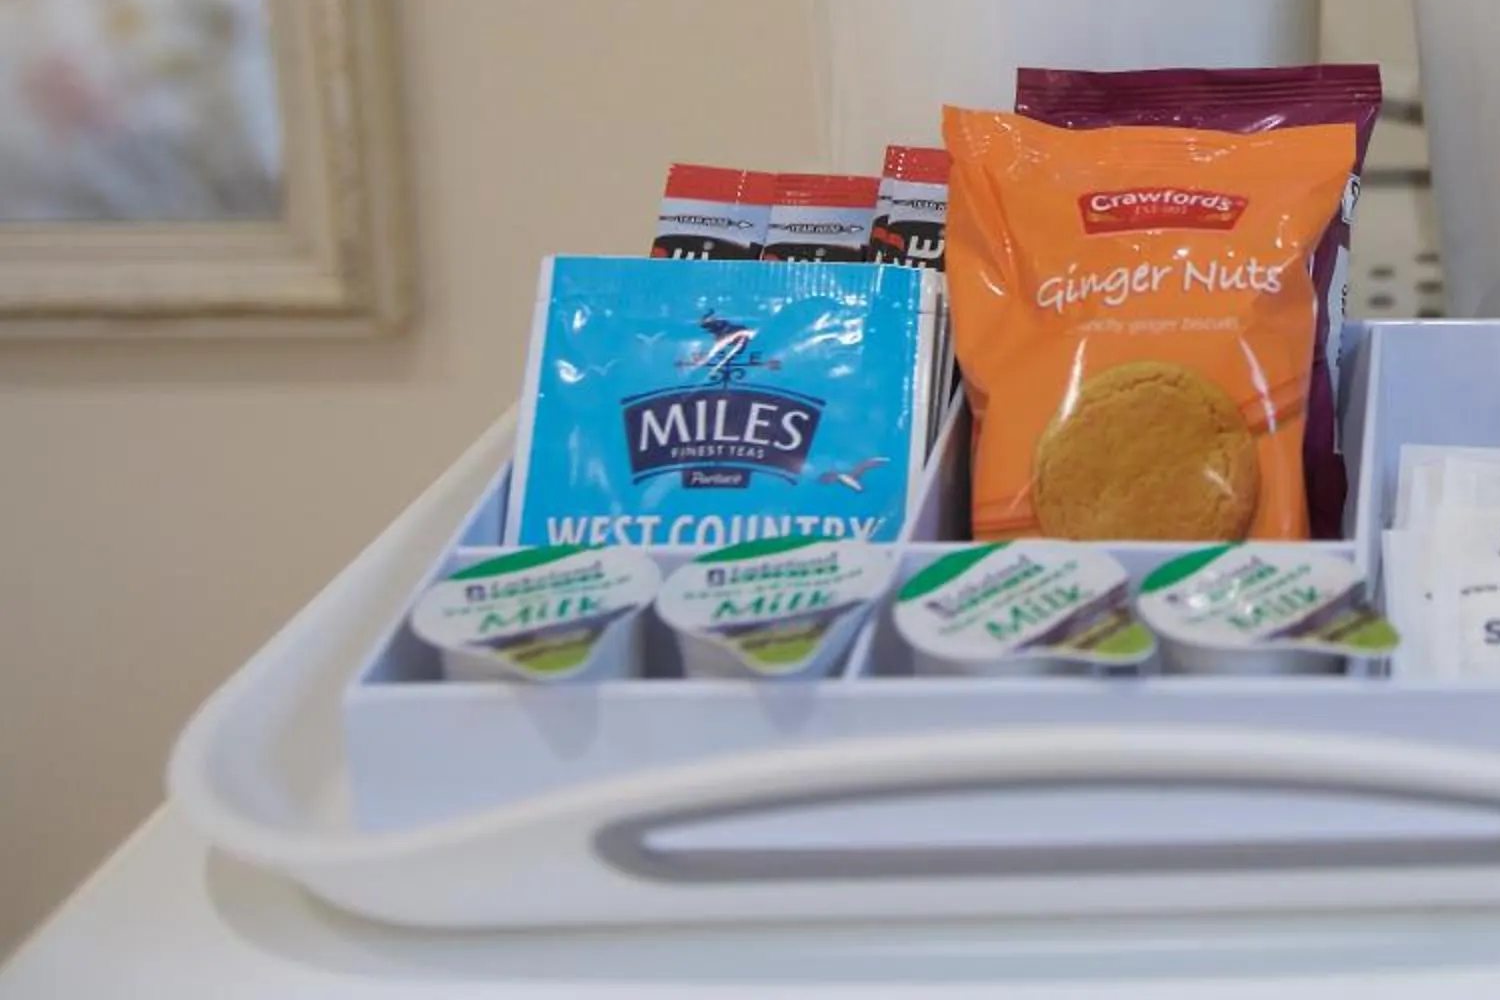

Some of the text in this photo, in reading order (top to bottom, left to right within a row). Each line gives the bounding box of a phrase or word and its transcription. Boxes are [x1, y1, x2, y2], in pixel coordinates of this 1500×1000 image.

[1036, 260, 1283, 313] Ginger Nuts
[639, 398, 809, 453] MILES
[671, 445, 766, 459] FINEST TEAS
[547, 516, 662, 547] WEST
[478, 596, 599, 633] Milk
[711, 591, 832, 621] Milk
[985, 583, 1082, 641] Milk
